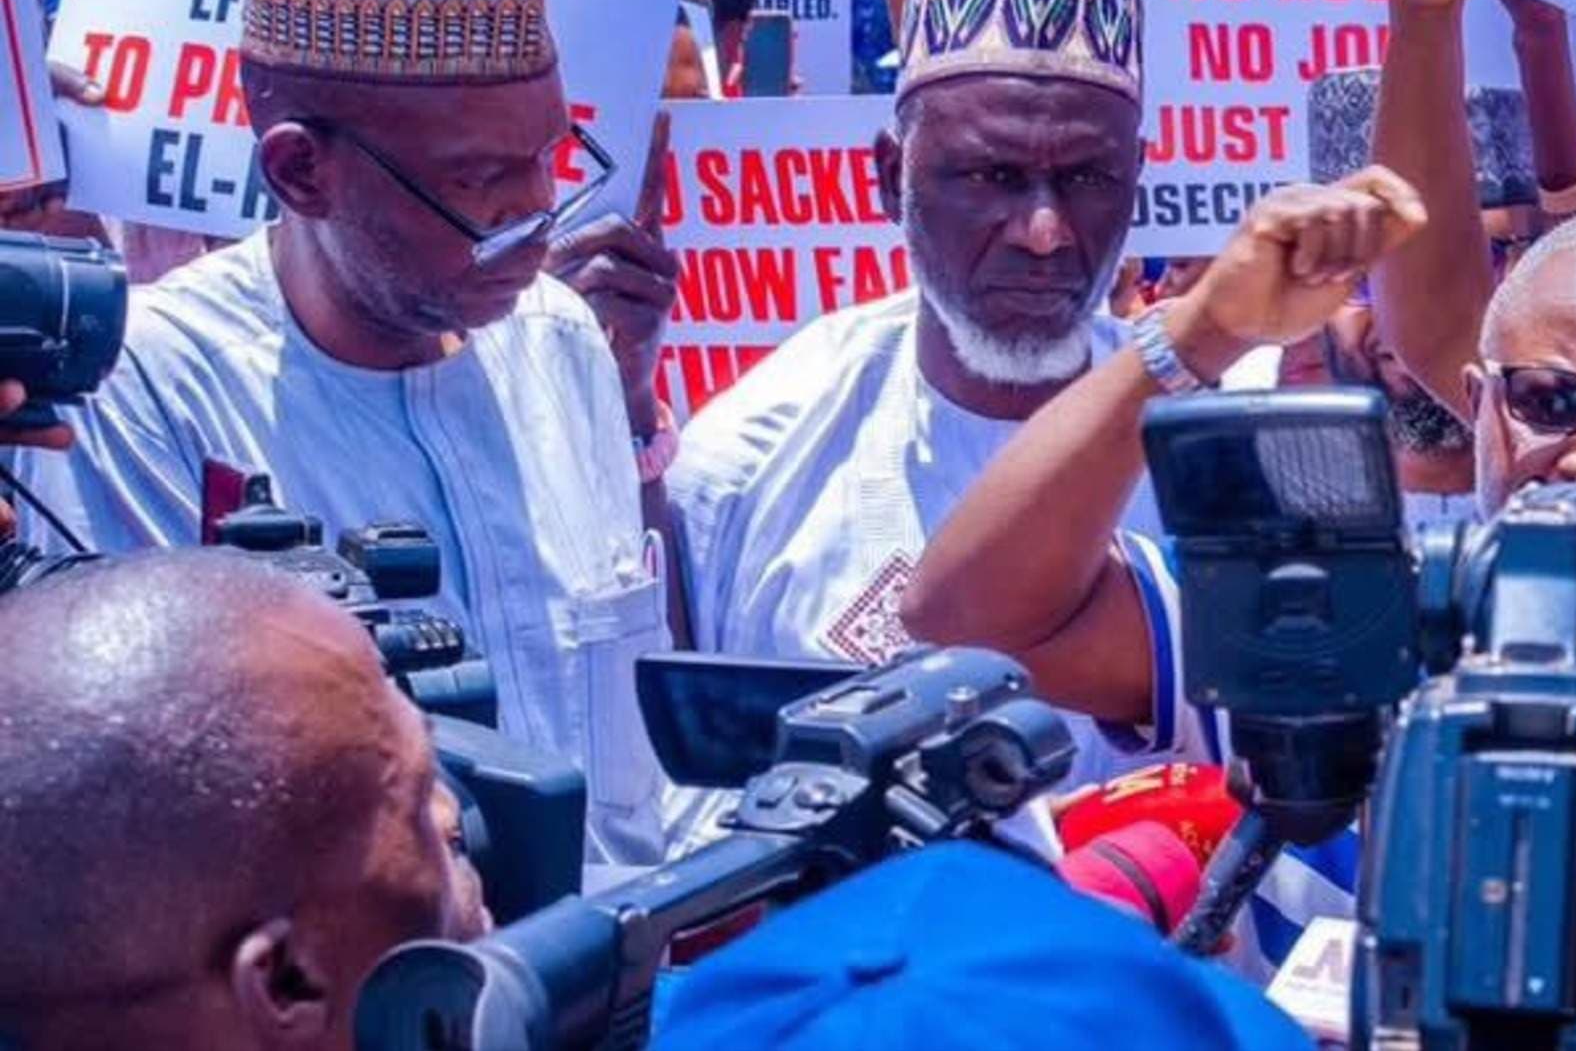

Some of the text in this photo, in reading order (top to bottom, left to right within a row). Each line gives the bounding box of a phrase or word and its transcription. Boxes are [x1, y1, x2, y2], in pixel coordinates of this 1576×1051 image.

[83, 32, 152, 112] TO
[1188, 22, 1393, 83] NO JO
[1144, 105, 1291, 165] JUST
[670, 246, 910, 324] NOW FA
